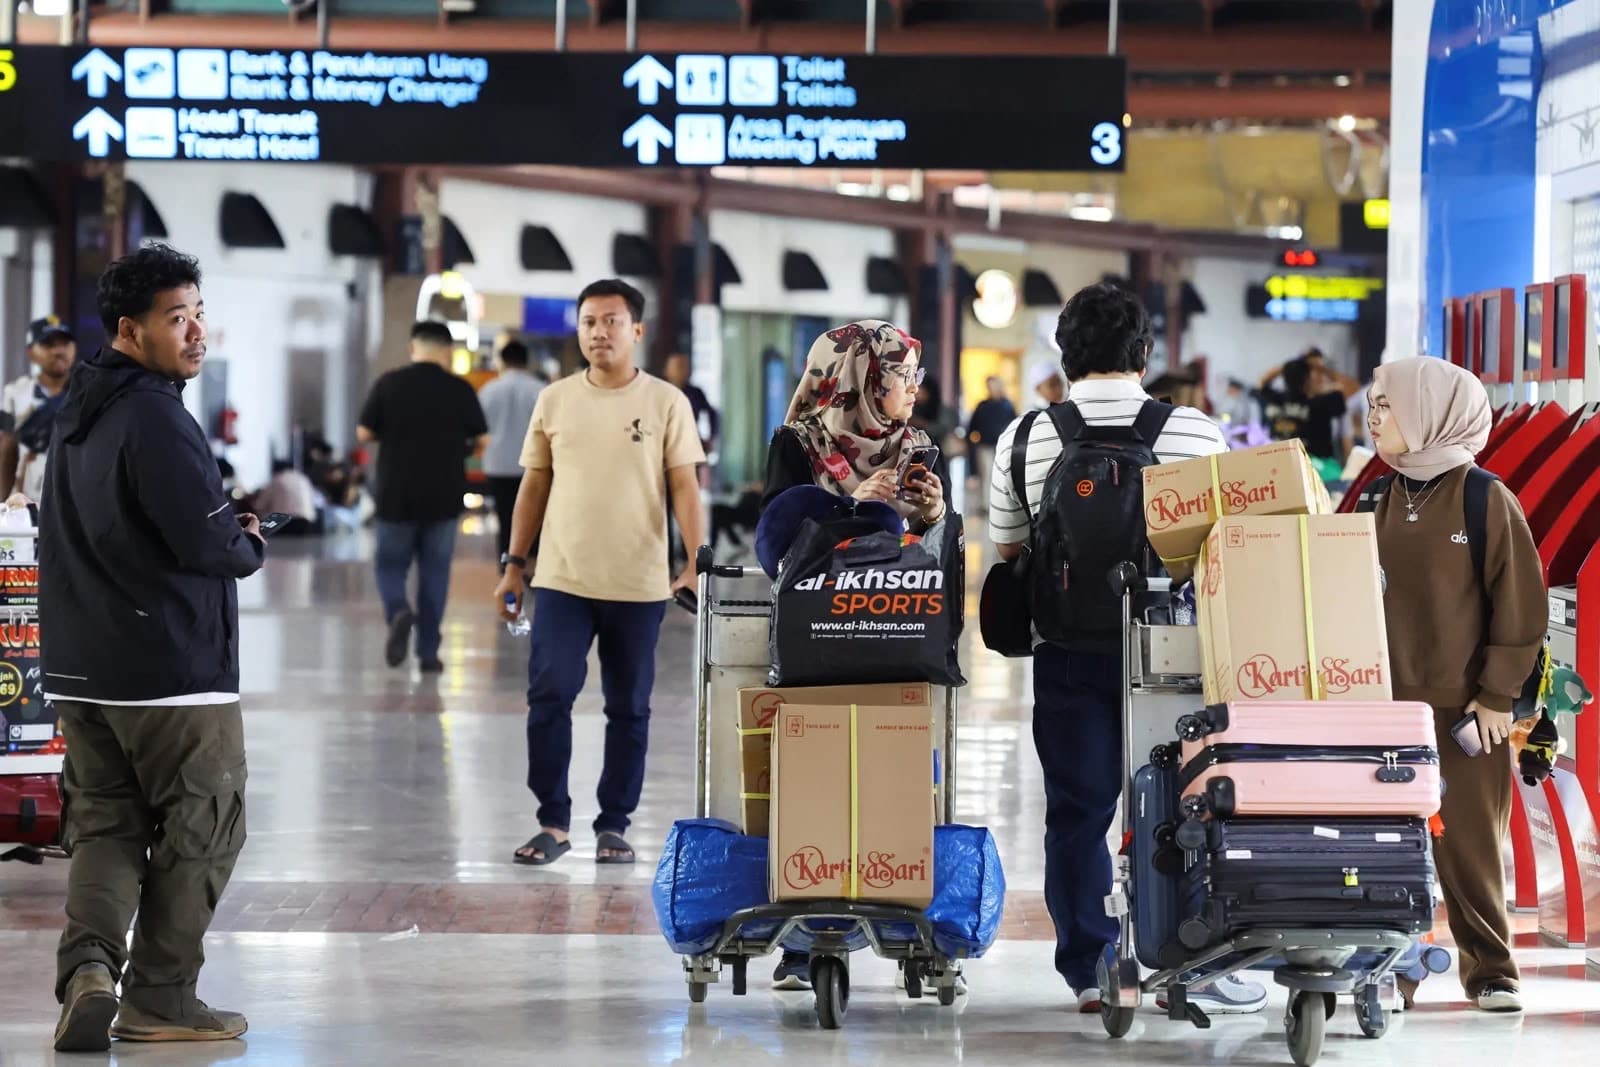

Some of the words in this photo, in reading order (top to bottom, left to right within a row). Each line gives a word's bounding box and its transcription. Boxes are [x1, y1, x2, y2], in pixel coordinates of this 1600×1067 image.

[229, 50, 287, 76] Bank
[289, 51, 309, 76] &
[782, 55, 846, 81] Toilet
[229, 75, 288, 100] Bank
[289, 76, 309, 100] &
[312, 76, 386, 106] Money
[388, 76, 481, 108] Changer
[781, 81, 857, 107] Toilets
[178, 108, 239, 134] Hotel
[239, 108, 319, 135] Transit
[728, 114, 783, 140] Area
[178, 133, 257, 160] Transit
[259, 134, 320, 160] Hotel
[728, 137, 817, 165] Meeting
[818, 137, 878, 160] Point
[1091, 121, 1121, 165] 3
[1450, 529, 1468, 544] alo
[794, 568, 944, 591] al-ikhsan
[831, 593, 943, 615] SPORTS
[811, 620, 925, 631] www.al-ikhsan.com
